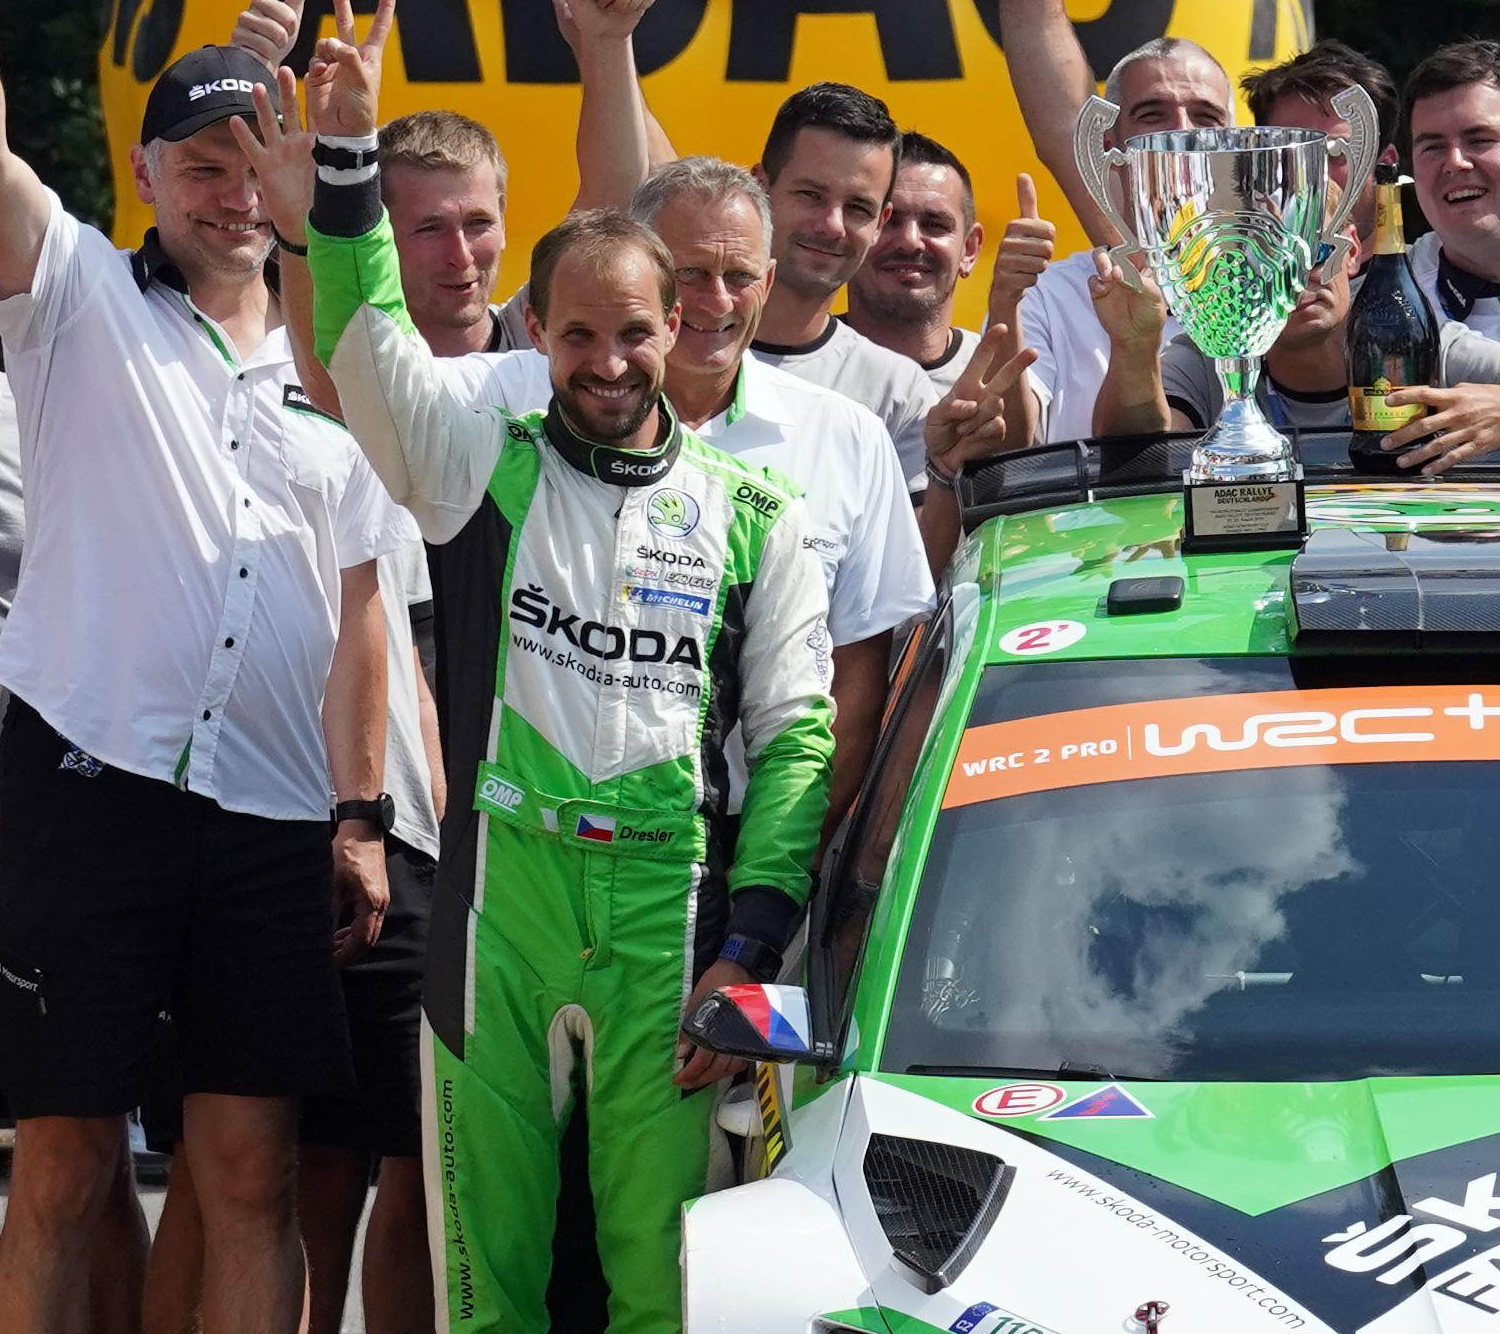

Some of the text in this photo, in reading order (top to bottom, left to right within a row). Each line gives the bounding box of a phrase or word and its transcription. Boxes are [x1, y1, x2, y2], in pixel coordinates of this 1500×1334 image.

[188, 79, 256, 102] ŠKOD
[736, 485, 780, 513] OMP
[636, 545, 706, 569] ŠKODA
[645, 593, 705, 610] MICHELIN
[509, 583, 702, 668] ŠKODA
[961, 737, 1118, 778] WRC 2 PRO
[480, 778, 524, 809] OMP
[618, 824, 675, 844] Dresler
[1044, 1168, 1306, 1331] www.skoda-motorsport.com
[955, 1319, 975, 1334] CZ
